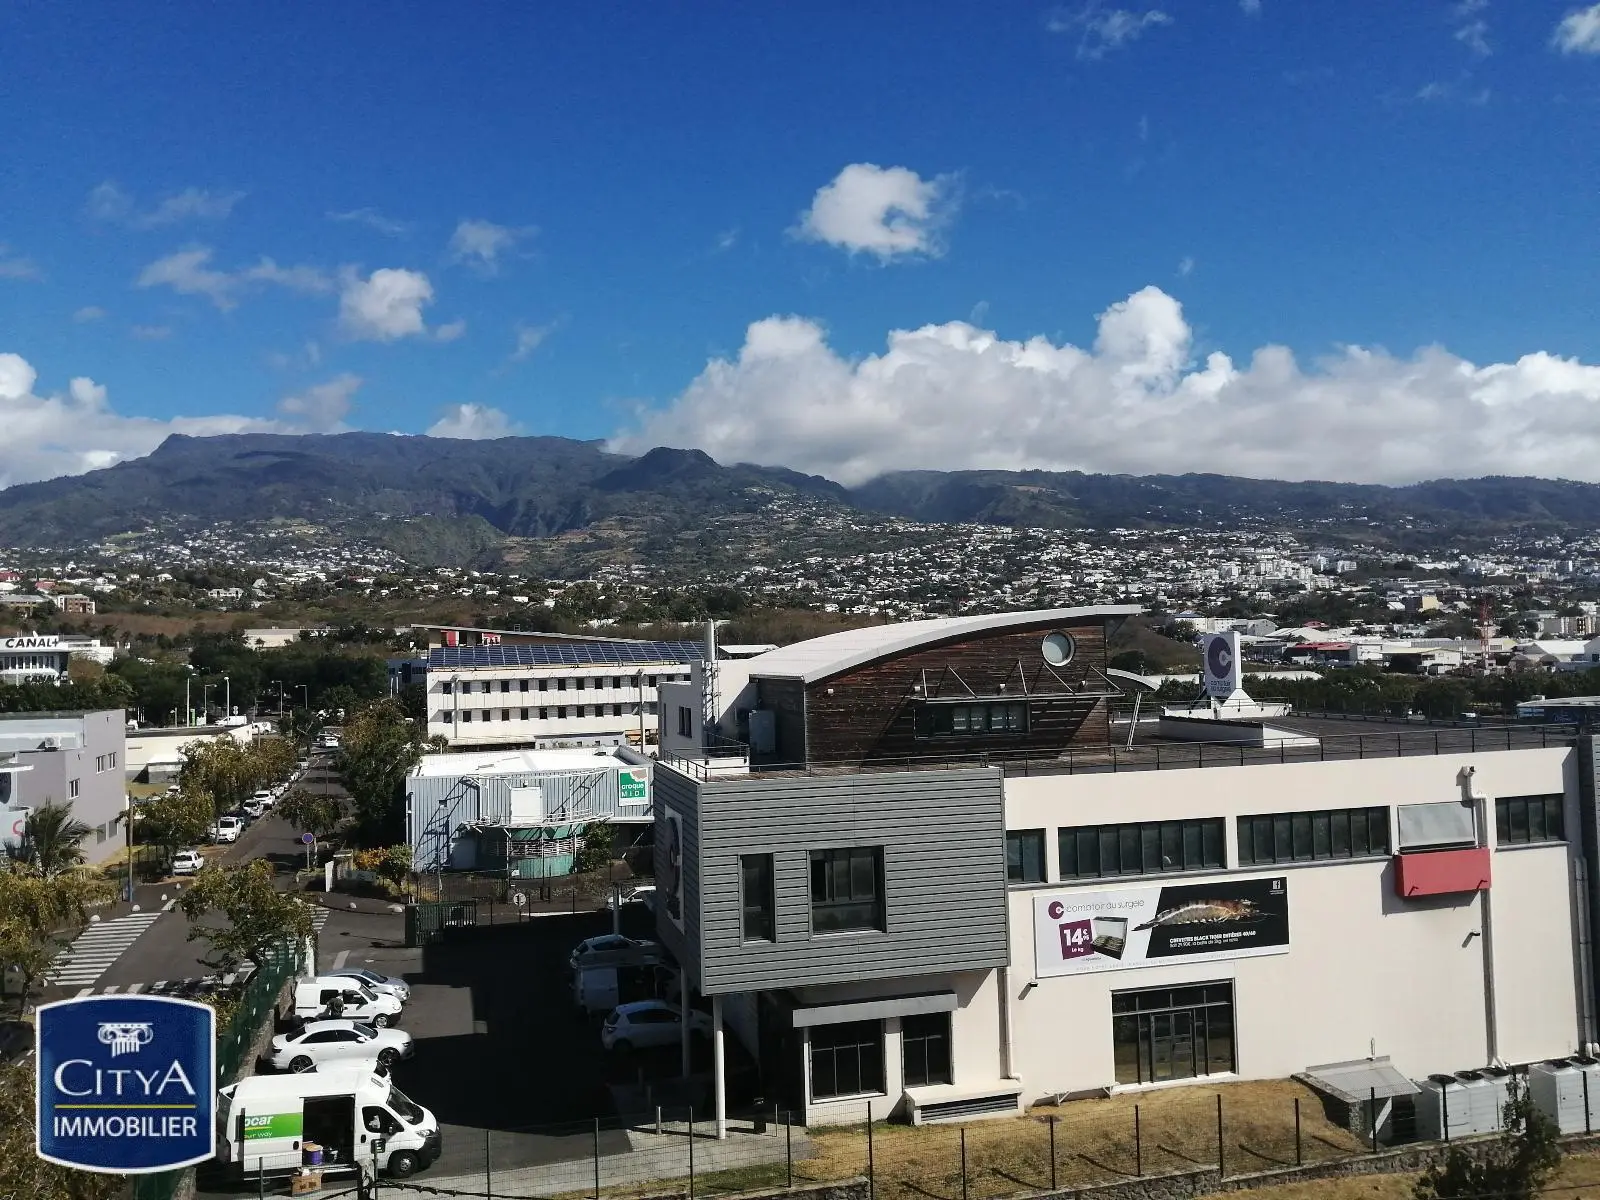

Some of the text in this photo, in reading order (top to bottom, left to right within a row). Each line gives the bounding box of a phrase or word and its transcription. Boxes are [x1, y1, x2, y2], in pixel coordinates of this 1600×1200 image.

[5, 638, 59, 648] CANAL+
[1063, 927, 1083, 946] 14
[257, 1130, 273, 1139] way
